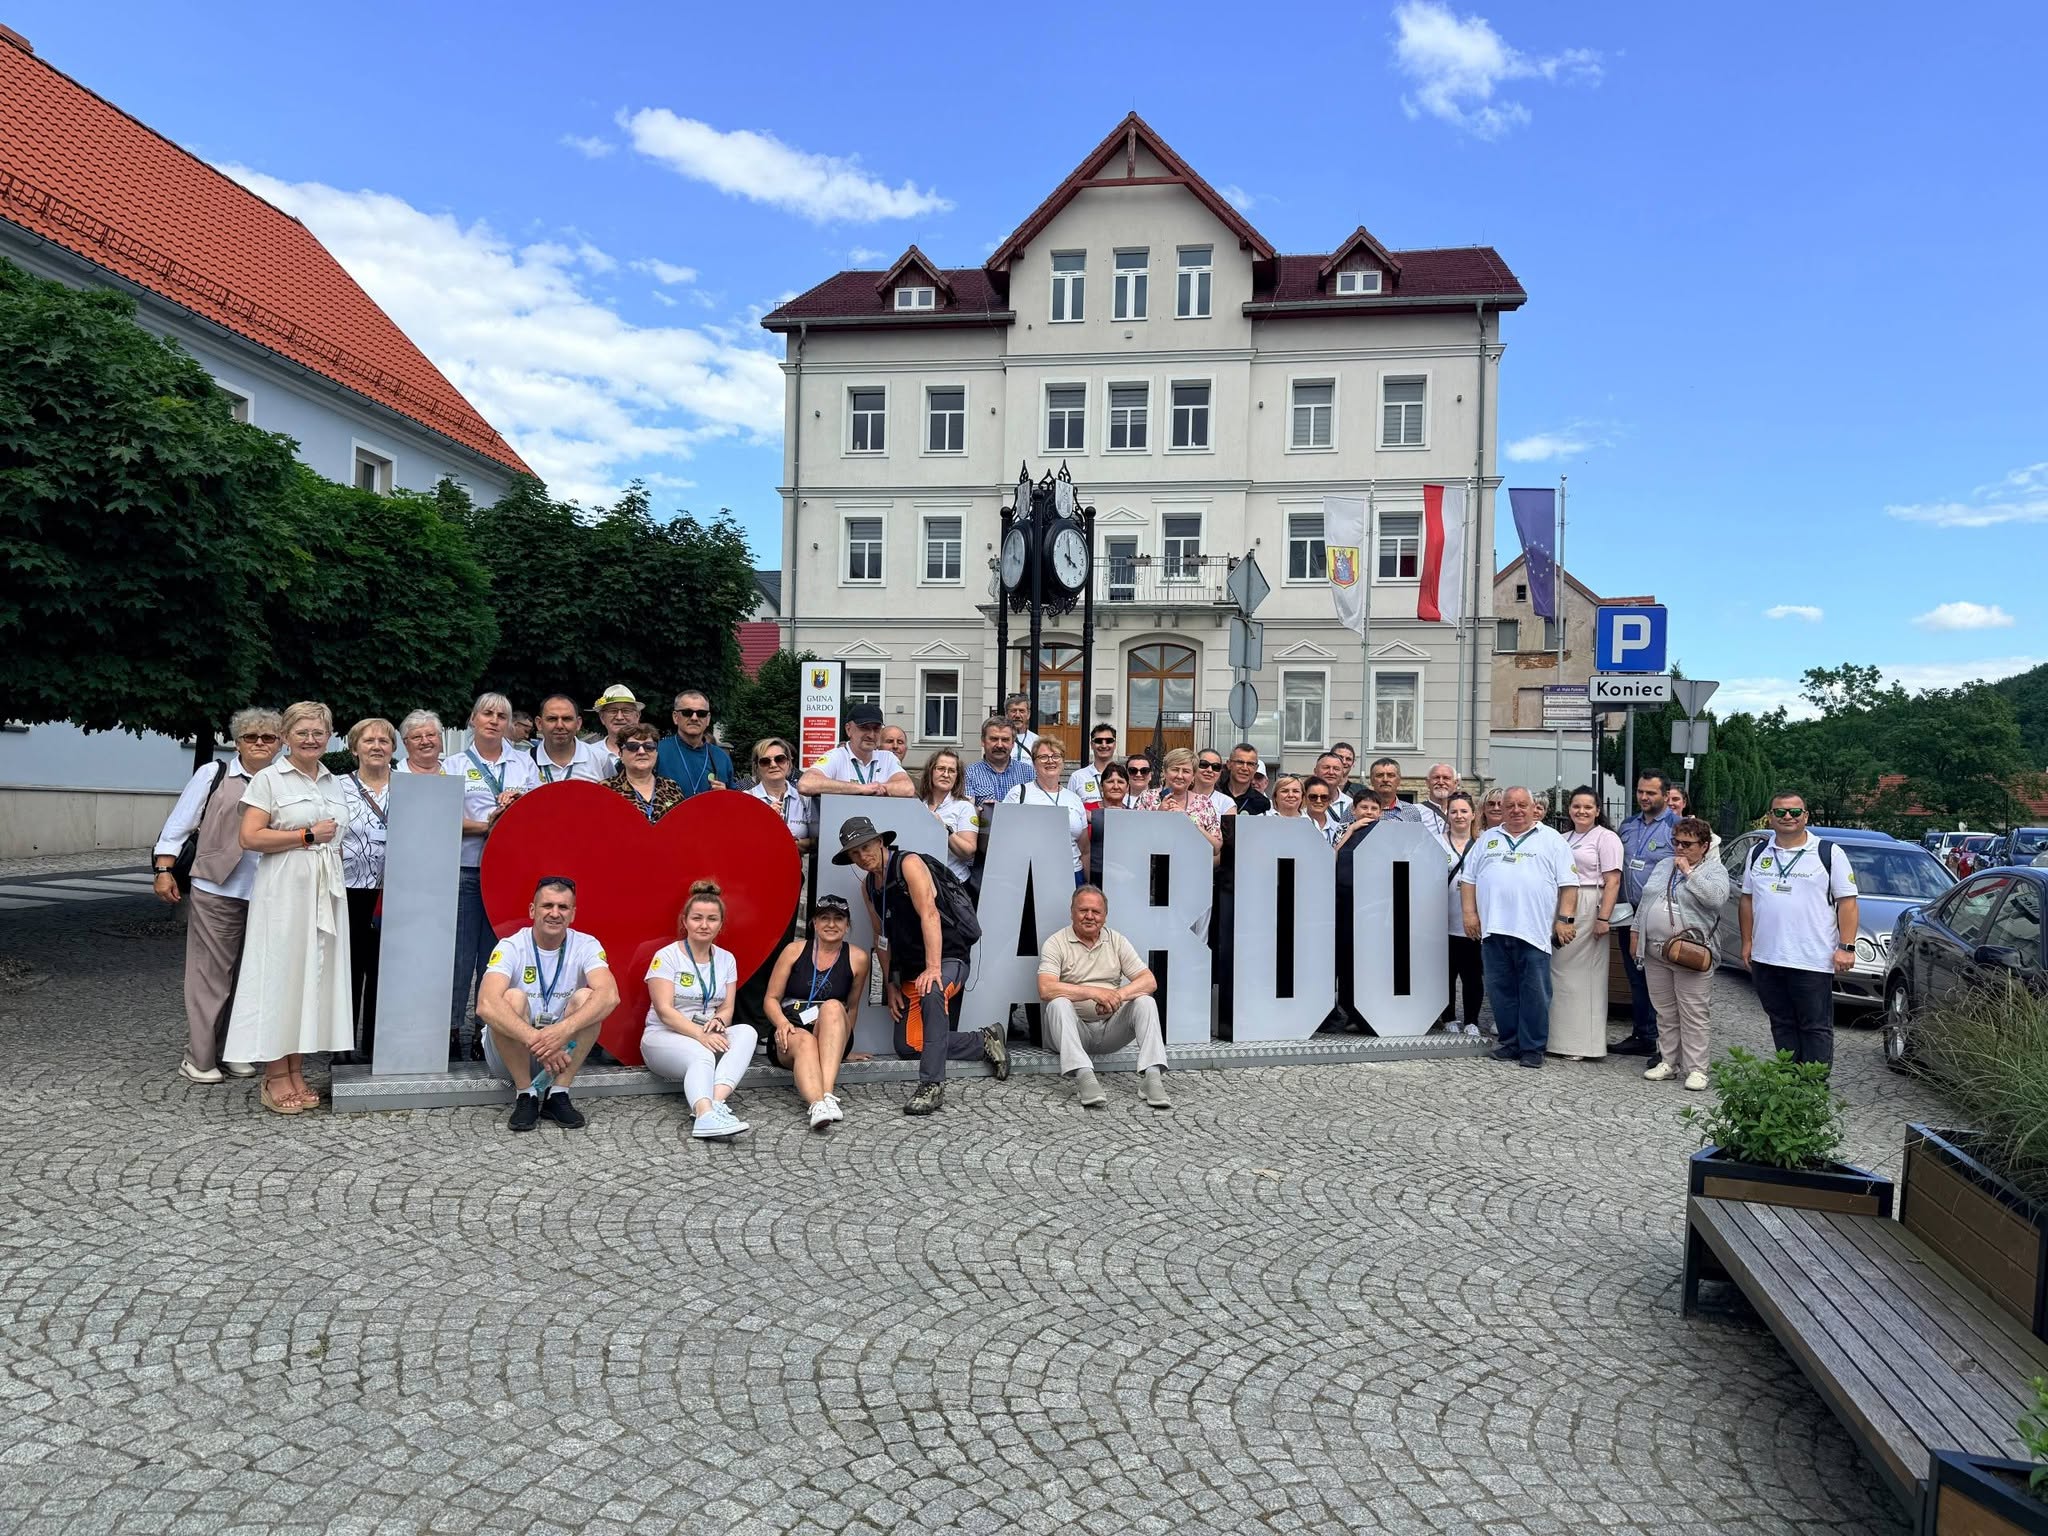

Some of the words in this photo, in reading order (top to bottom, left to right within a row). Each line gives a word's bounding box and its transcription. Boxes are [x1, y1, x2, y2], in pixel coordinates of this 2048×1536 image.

[1612, 614, 1651, 664] P
[1596, 681, 1664, 697] Koniec
[806, 695, 833, 703] GMINA
[806, 704, 834, 712] BARDO
[372, 772, 466, 1075] I
[813, 794, 1449, 1055] BARDO
